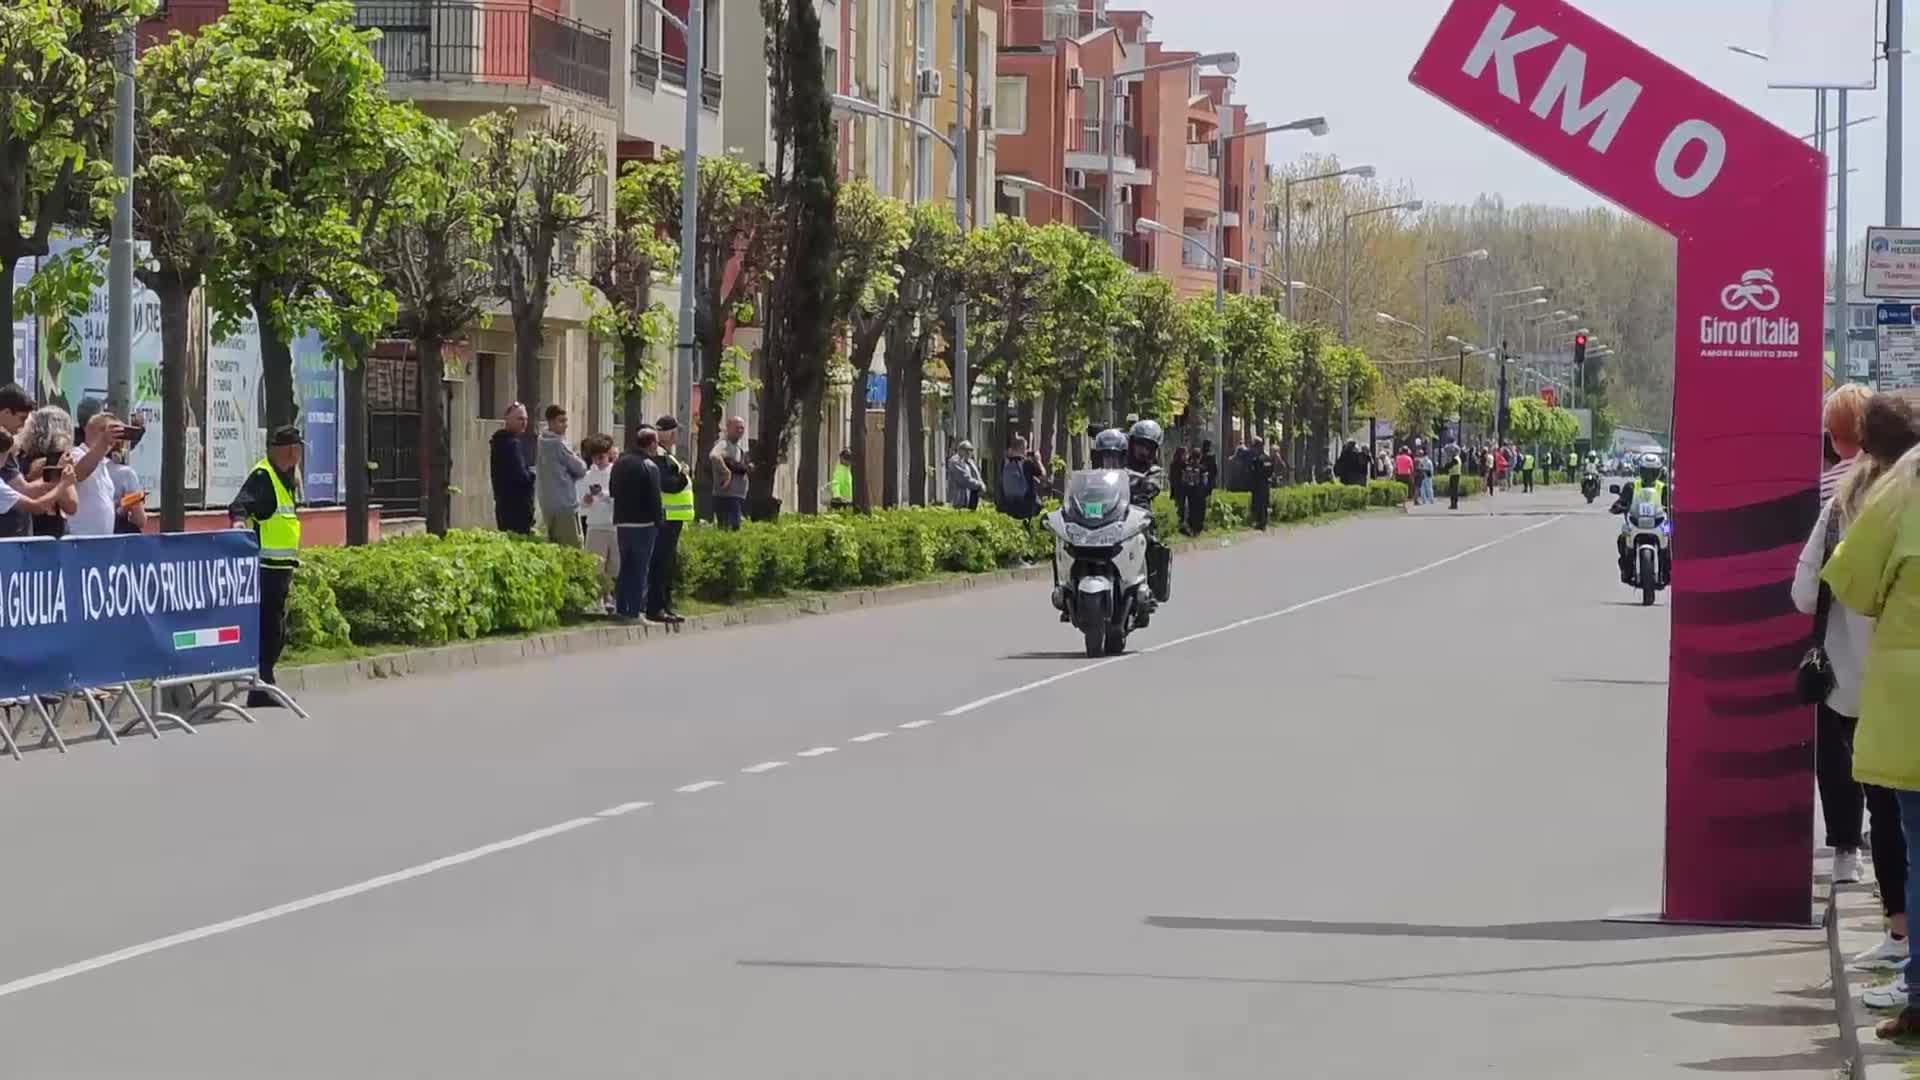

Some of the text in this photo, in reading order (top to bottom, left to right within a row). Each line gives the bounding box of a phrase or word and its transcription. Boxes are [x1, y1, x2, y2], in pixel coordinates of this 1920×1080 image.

[1461, 3, 1643, 154] KM
[1700, 316, 1799, 345] Giro d'Italia
[1701, 350, 1733, 358] AMORE
[1735, 350, 1775, 358] INFINITO
[8, 568, 67, 628] GIULIA
[81, 566, 105, 622] IO
[106, 562, 159, 618] SONO
[160, 560, 205, 612] FRIULI
[206, 556, 260, 608] VENEZI
